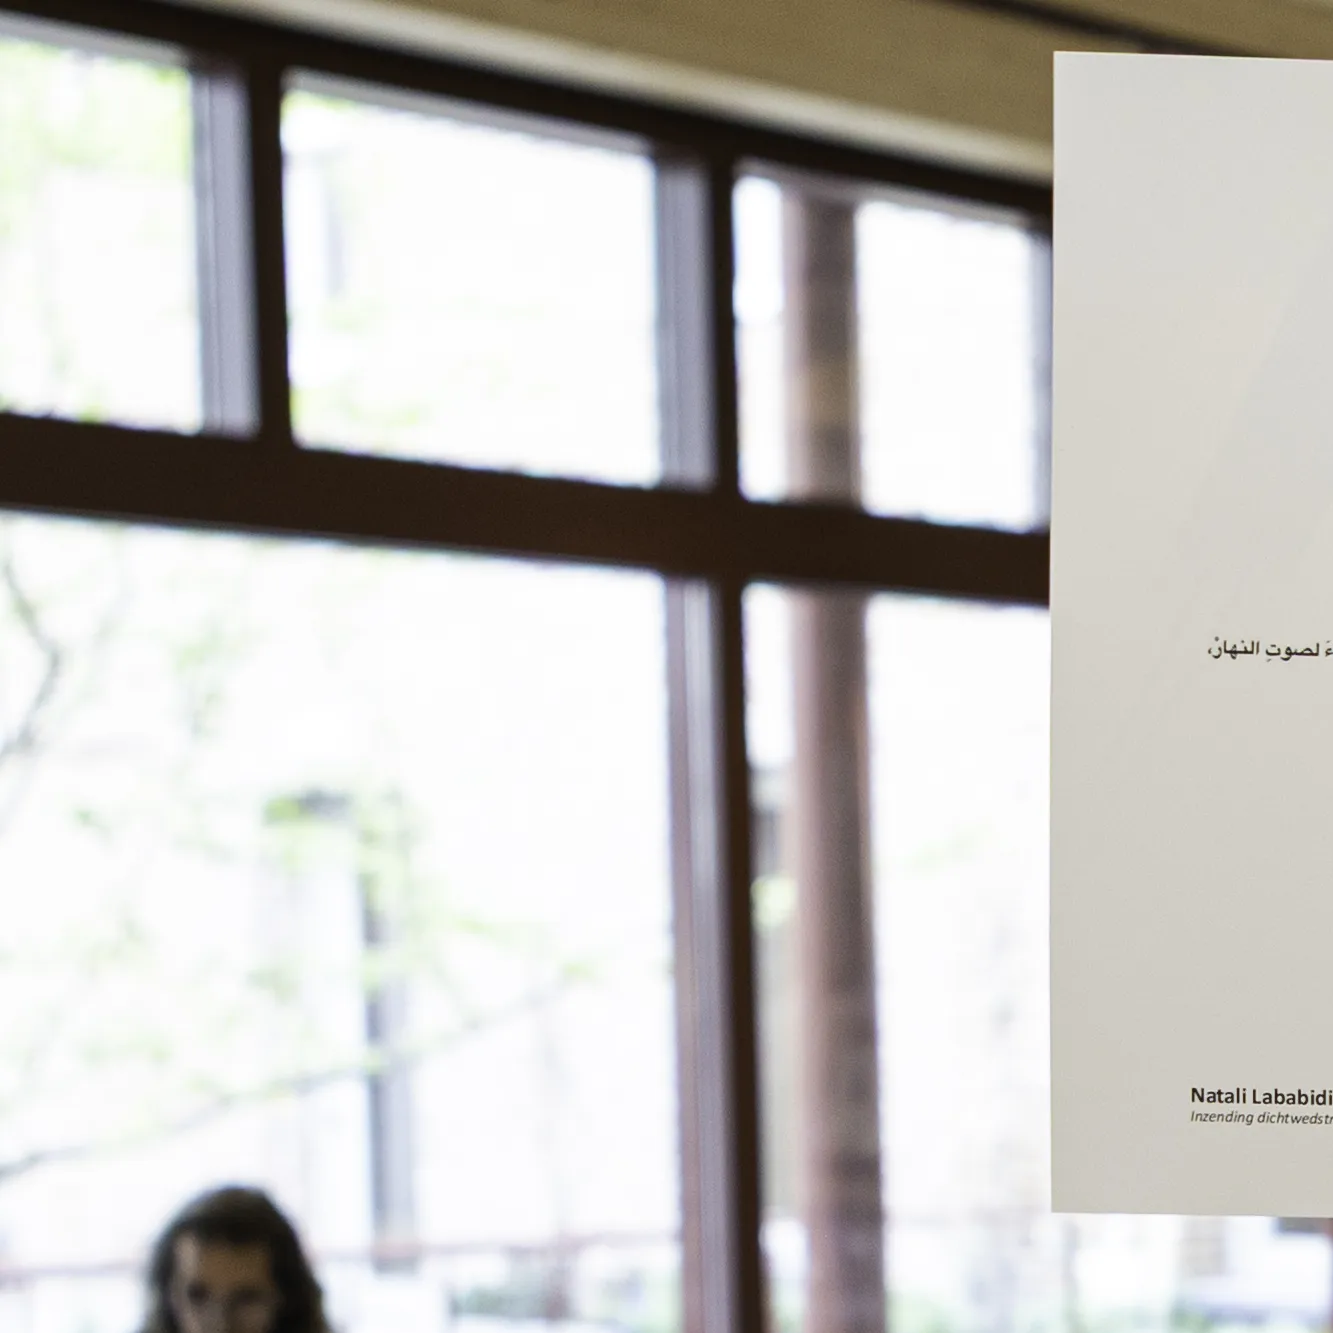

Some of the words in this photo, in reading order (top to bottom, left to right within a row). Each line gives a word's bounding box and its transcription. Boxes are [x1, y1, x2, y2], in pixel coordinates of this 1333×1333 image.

[1191, 1087, 1246, 1104] Natali
[1253, 1088, 1333, 1106] Lababidi
[1191, 1110, 1254, 1126] Inzending
